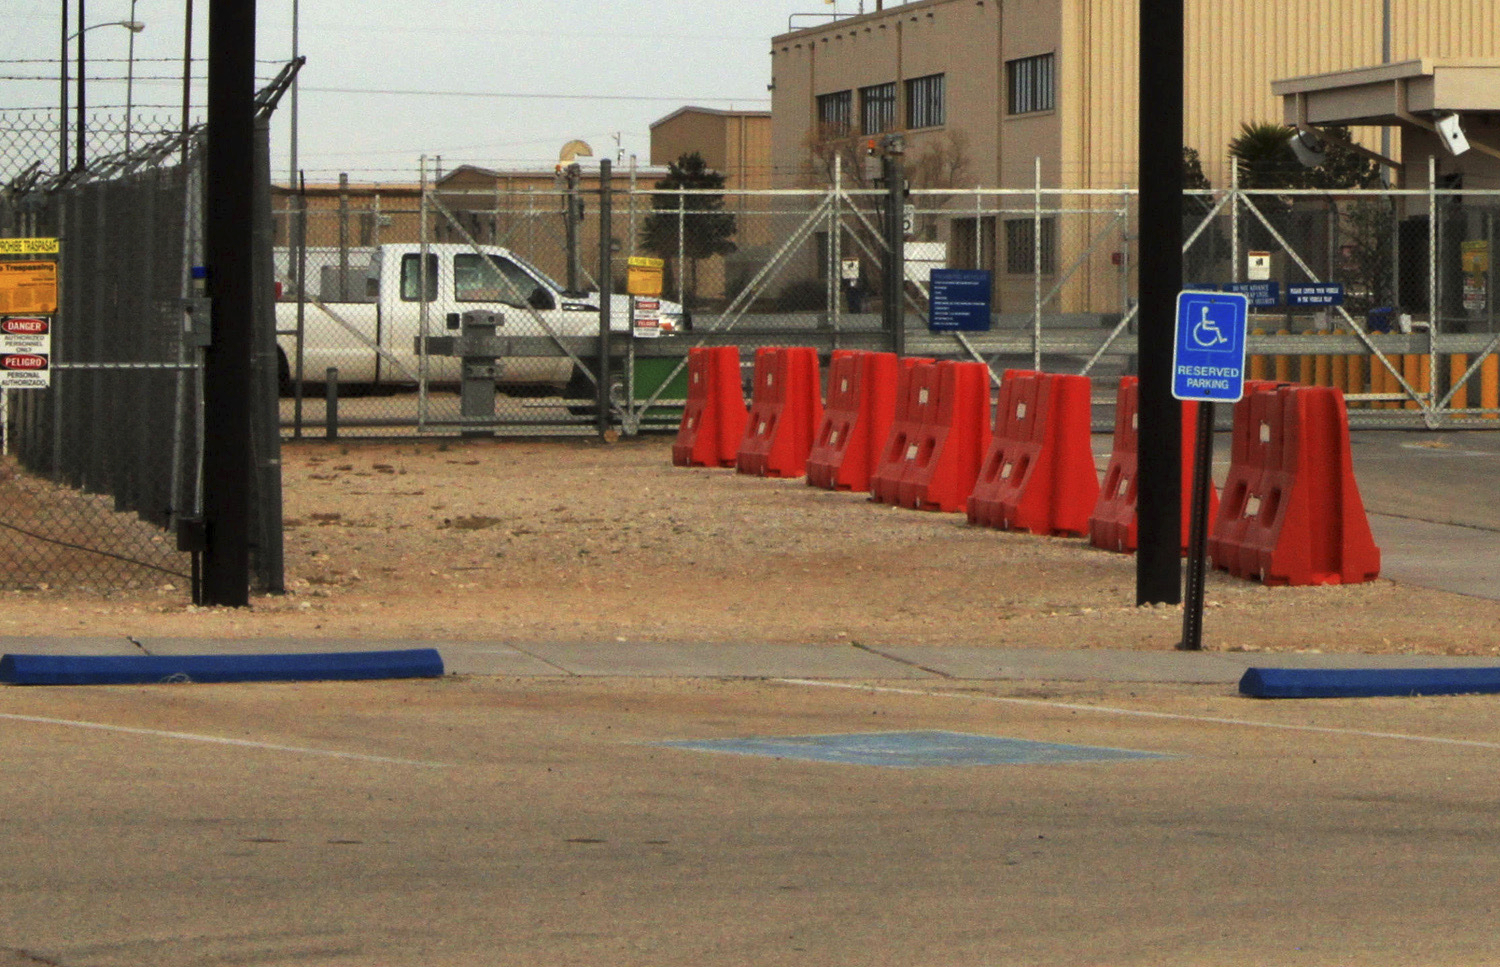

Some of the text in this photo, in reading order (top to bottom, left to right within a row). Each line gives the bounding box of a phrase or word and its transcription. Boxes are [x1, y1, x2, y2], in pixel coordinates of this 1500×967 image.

[6, 264, 54, 272] Trespassing
[8, 321, 42, 331] DANGER
[5, 357, 42, 366] PELIGRO
[1178, 365, 1239, 378] RESERVED
[1187, 378, 1229, 389] PARKING
